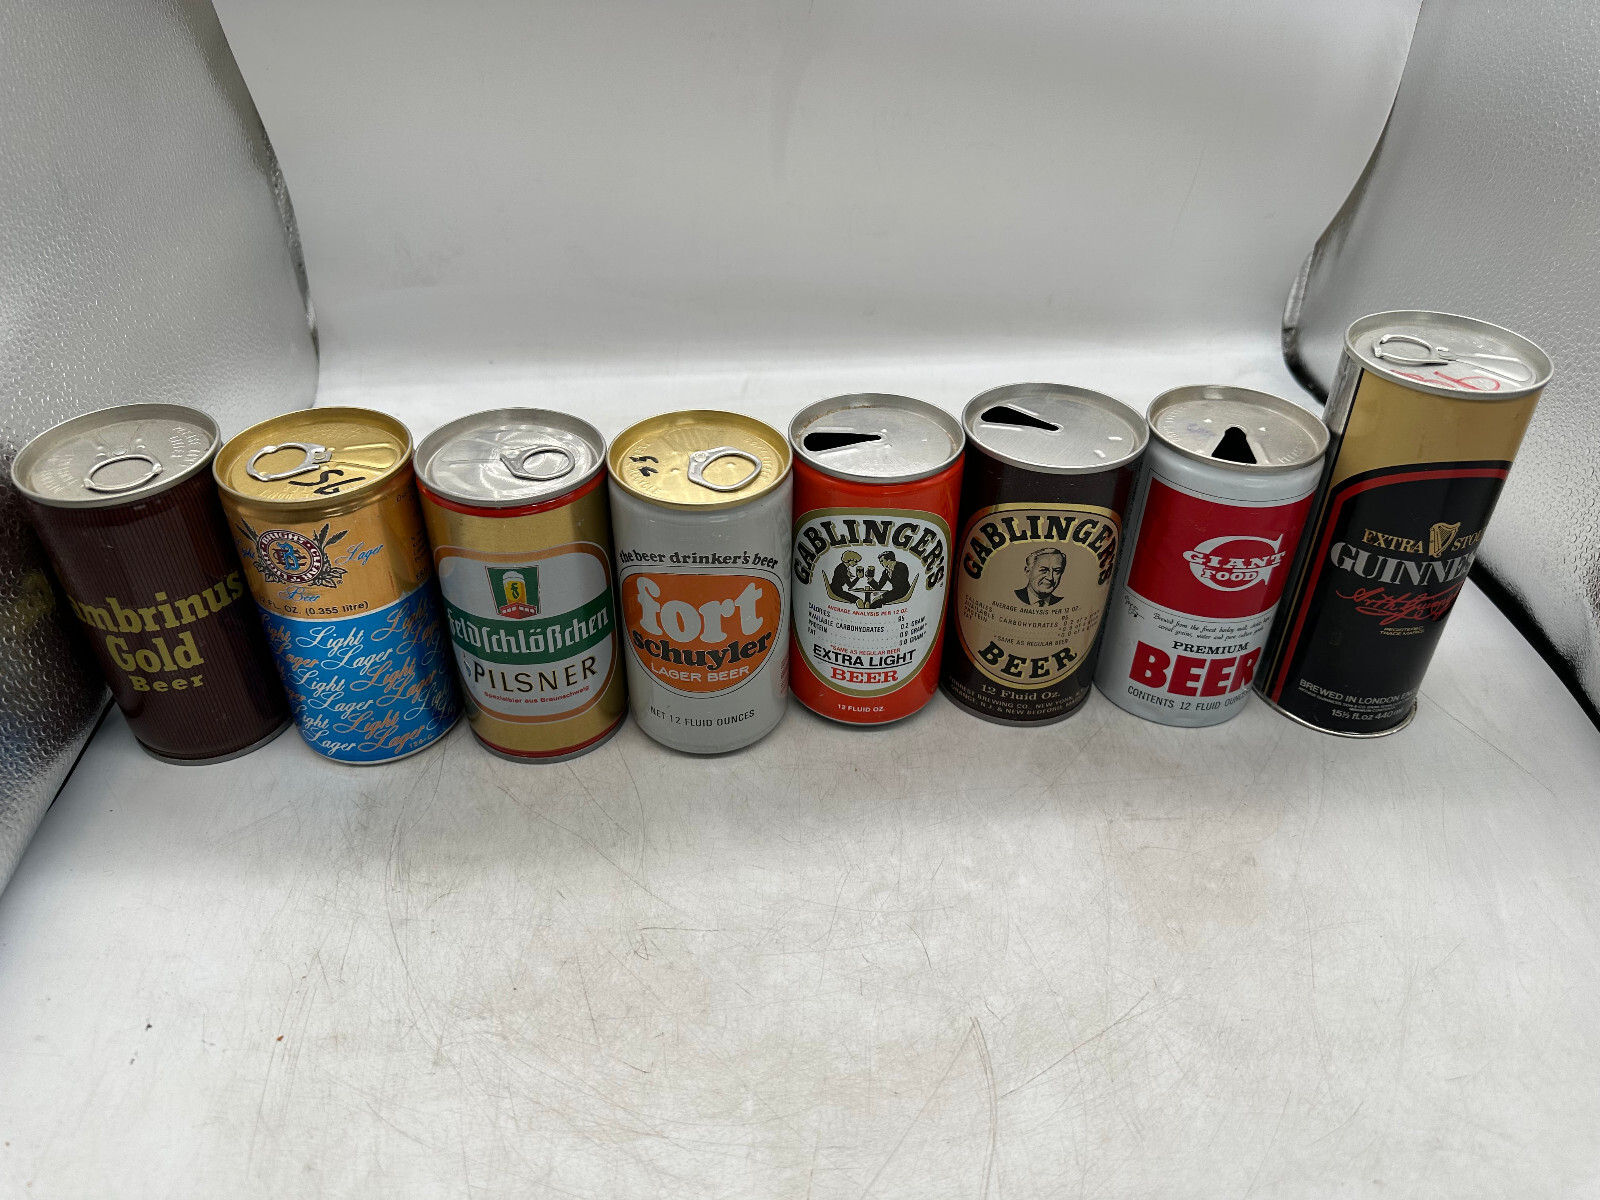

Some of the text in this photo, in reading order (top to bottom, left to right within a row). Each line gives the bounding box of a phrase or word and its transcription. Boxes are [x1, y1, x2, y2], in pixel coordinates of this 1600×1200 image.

[1361, 528, 1424, 554] EXTRA
[335, 541, 384, 566] Lager
[619, 549, 779, 569] the beer drinker's beer
[794, 519, 946, 591] GABLINGER'S
[1182, 550, 1286, 570] GIANT
[1200, 568, 1260, 582] FOOD
[67, 571, 244, 633] ambrinus
[278, 586, 321, 602] Beer
[305, 606, 338, 616] (0.355
[342, 600, 369, 613] litre)
[636, 576, 763, 643] fort
[808, 602, 831, 618] CALORIES
[827, 604, 851, 614] AVERAGE
[992, 600, 1018, 613] AVERAGE
[1019, 607, 1049, 615] ANALYSIS
[808, 611, 834, 627] AVAILABLE
[836, 622, 885, 633] CARBOHYDRATES
[808, 618, 828, 634] PROTEIN
[998, 616, 1059, 628] CARBOHYDRATES
[1152, 612, 1174, 625] Brewed
[1190, 624, 1200, 632] the
[1200, 625, 1217, 634] finest
[105, 631, 205, 673] Gold
[296, 626, 365, 658] Light
[632, 630, 772, 671] schuyler
[886, 647, 901, 655] BEER
[1054, 638, 1069, 646] BEER
[1171, 640, 1250, 656] PREMIUM
[321, 645, 393, 676] Lager
[813, 643, 917, 668] EXTRA LIGHT
[978, 640, 1078, 680] BEER
[350, 660, 417, 694] Light
[474, 656, 598, 693] PILSNER
[650, 662, 750, 682] LAGER BEER
[830, 666, 899, 684] BEER
[1128, 640, 1262, 698] BEER
[128, 673, 205, 693] Beer
[288, 669, 346, 698] Light
[376, 669, 437, 707] Lager
[981, 684, 1061, 700] 12 Fluid Oz.
[1300, 678, 1344, 701] BREWED
[1345, 695, 1358, 703] IN
[1358, 694, 1400, 705] LONDON
[484, 691, 522, 703] Spezialbier
[540, 686, 590, 703] Braunschweig
[977, 694, 1014, 709] BREWING
[1127, 685, 1175, 709] CONTENTS
[1179, 702, 1192, 711] 12
[1195, 701, 1221, 711] FLUID
[308, 692, 374, 720] Lager
[650, 706, 756, 727] NET 12 FLUID OUNCES
[837, 703, 846, 711] 12
[847, 704, 871, 713] FLUID
[1375, 710, 1394, 720] 440
[333, 711, 400, 740] Light
[303, 726, 357, 756] Lager
[358, 724, 426, 755] Lager
